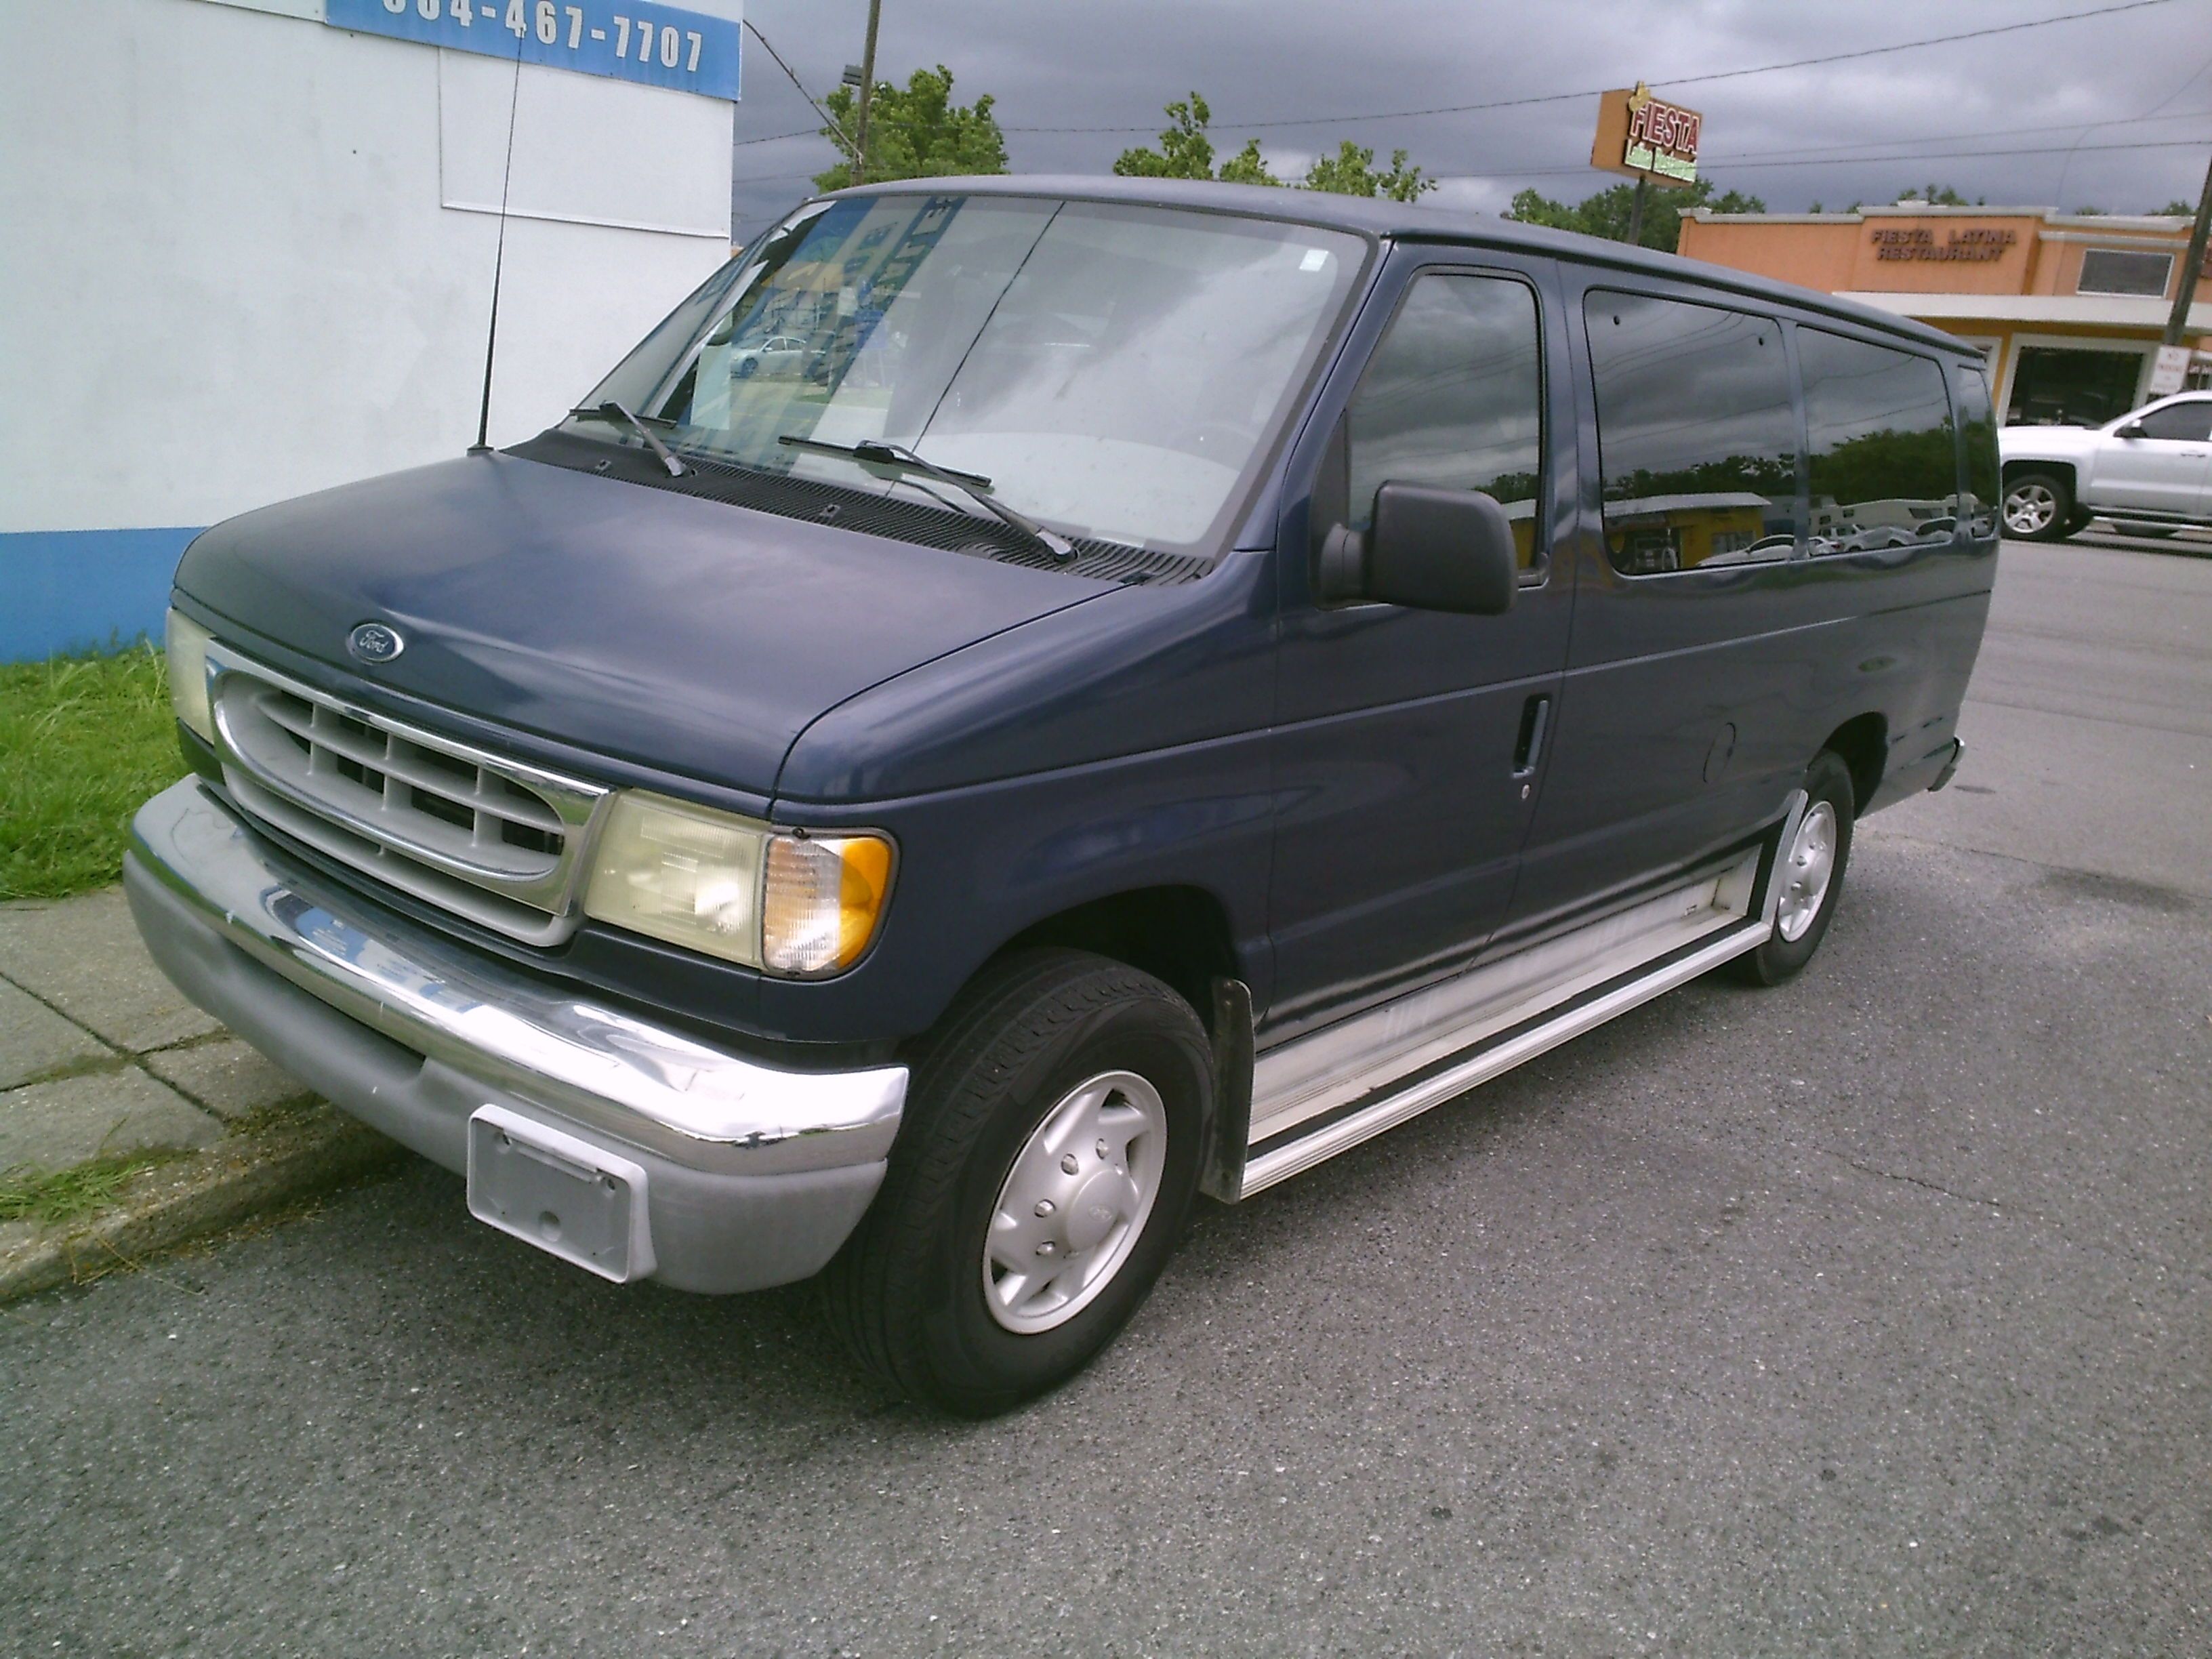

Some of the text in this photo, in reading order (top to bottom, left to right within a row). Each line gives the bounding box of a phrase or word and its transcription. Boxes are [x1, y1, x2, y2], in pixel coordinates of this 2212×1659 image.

[1630, 101, 1700, 155] FIESTA
[1871, 228, 2017, 245] FIESTA LATINA
[1877, 245, 2004, 262] RESTAURANT
[359, 630, 389, 653] Ford
